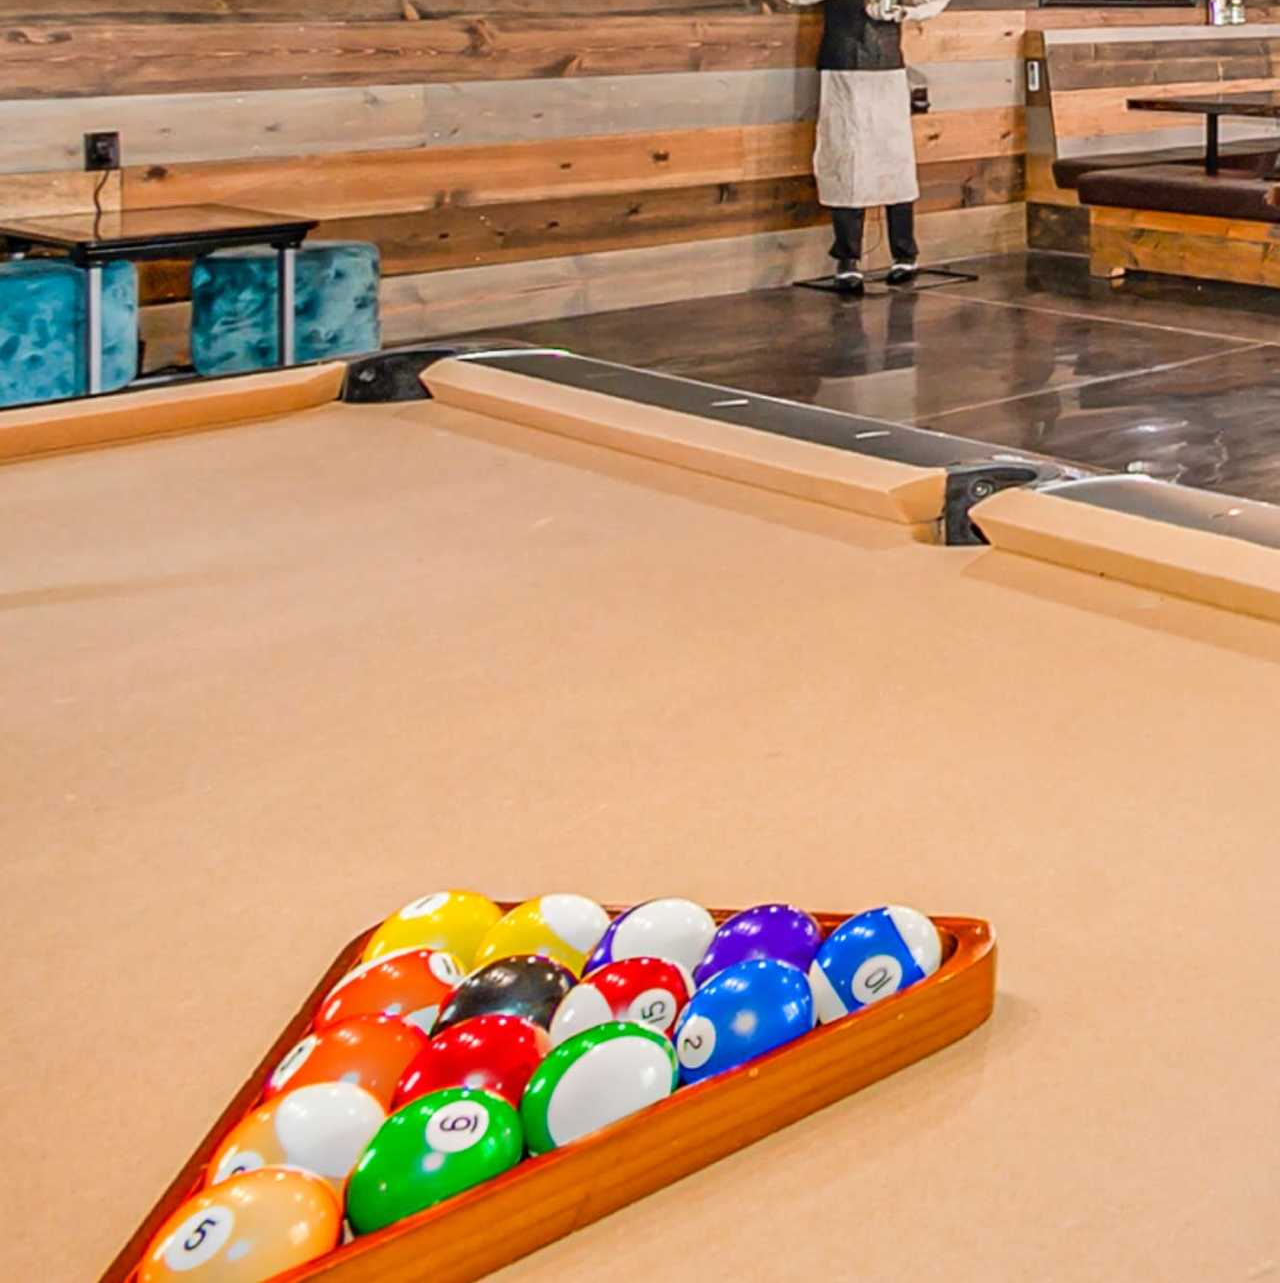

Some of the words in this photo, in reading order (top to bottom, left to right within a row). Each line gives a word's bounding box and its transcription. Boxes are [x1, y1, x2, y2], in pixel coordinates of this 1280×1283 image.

[641, 1000, 666, 1024] 15
[683, 1035, 703, 1052] 2
[184, 1218, 216, 1250] 5
